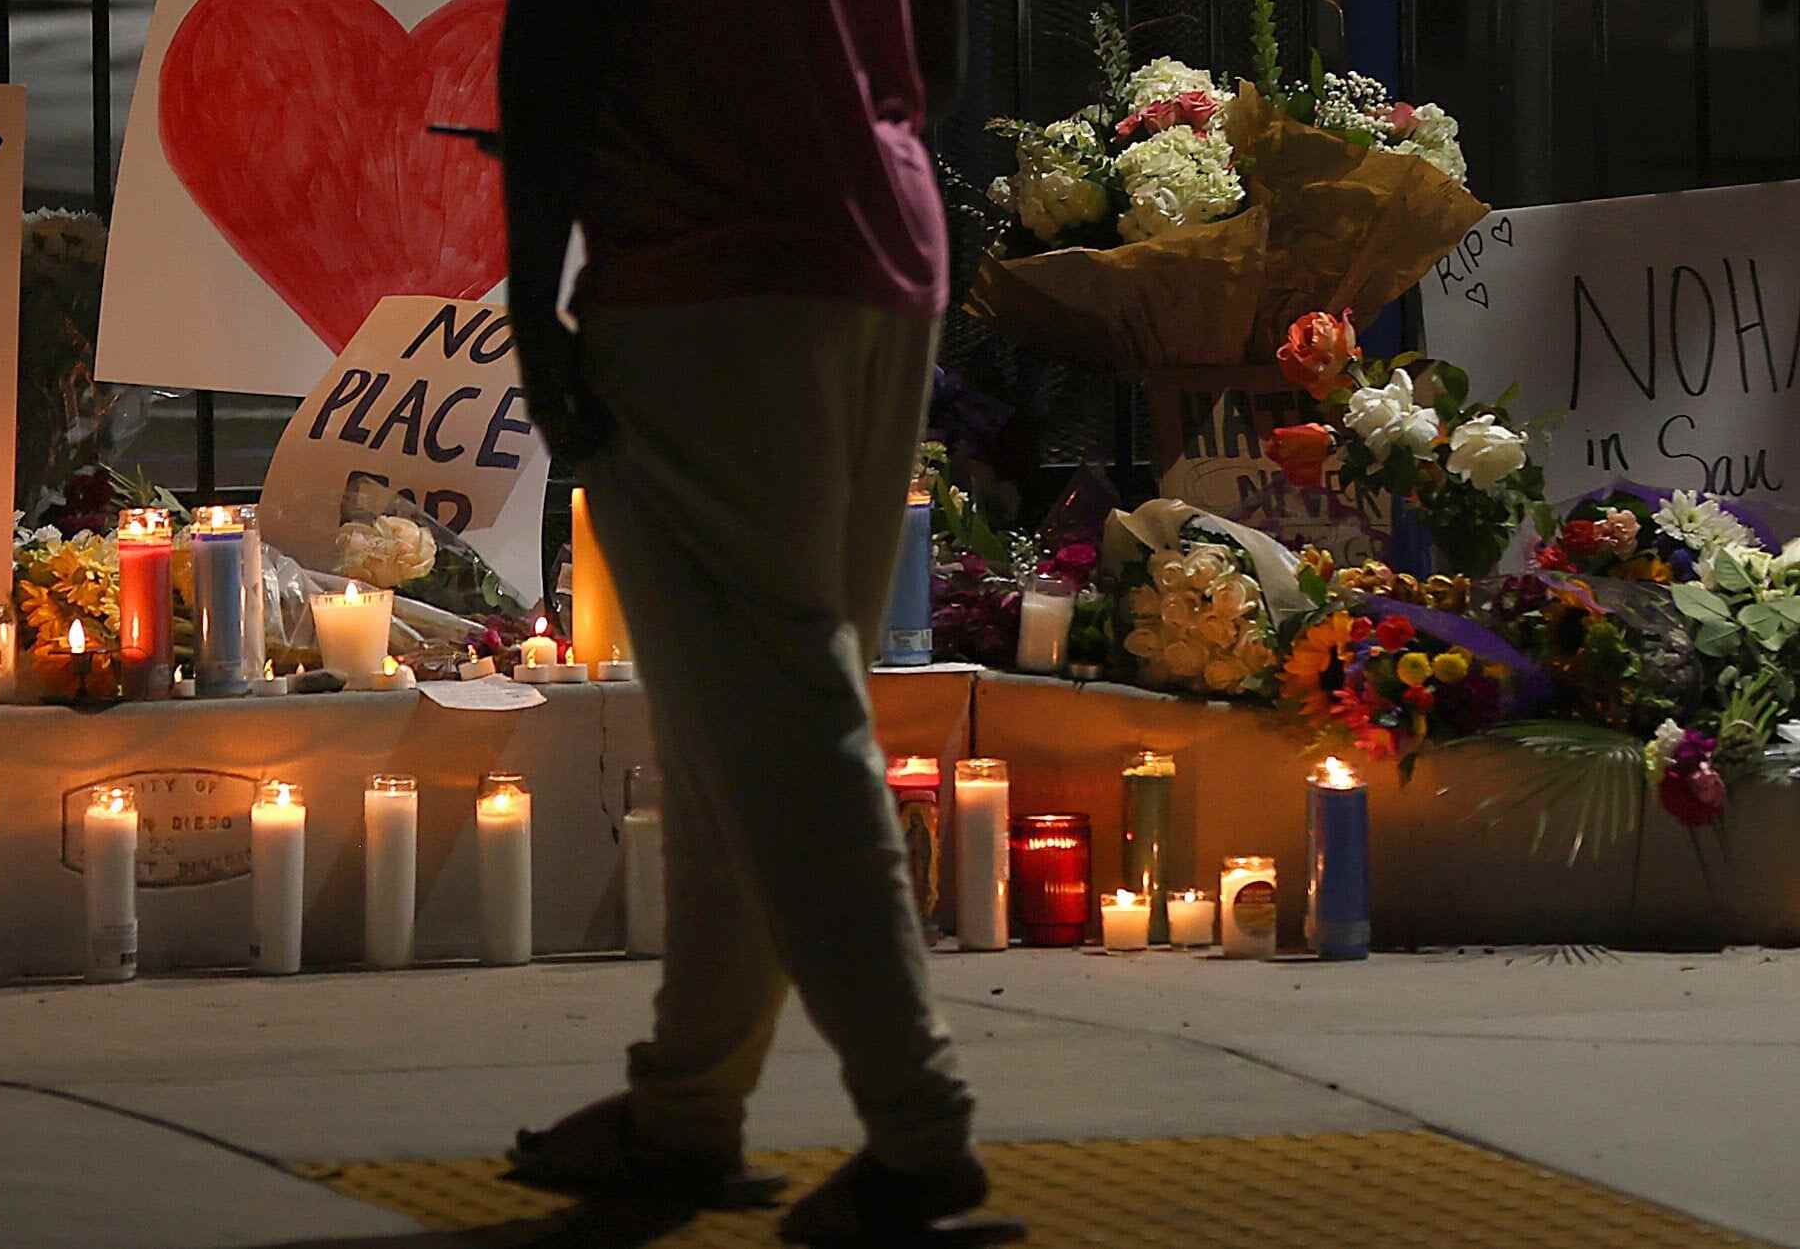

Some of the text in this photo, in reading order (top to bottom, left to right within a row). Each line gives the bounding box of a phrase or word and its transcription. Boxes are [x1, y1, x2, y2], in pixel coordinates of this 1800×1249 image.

[1435, 230, 1484, 295] RIP
[1569, 257, 1800, 410] NOH
[308, 369, 531, 469] PLACE
[1586, 429, 1628, 471] in
[130, 778, 176, 794] ITY
